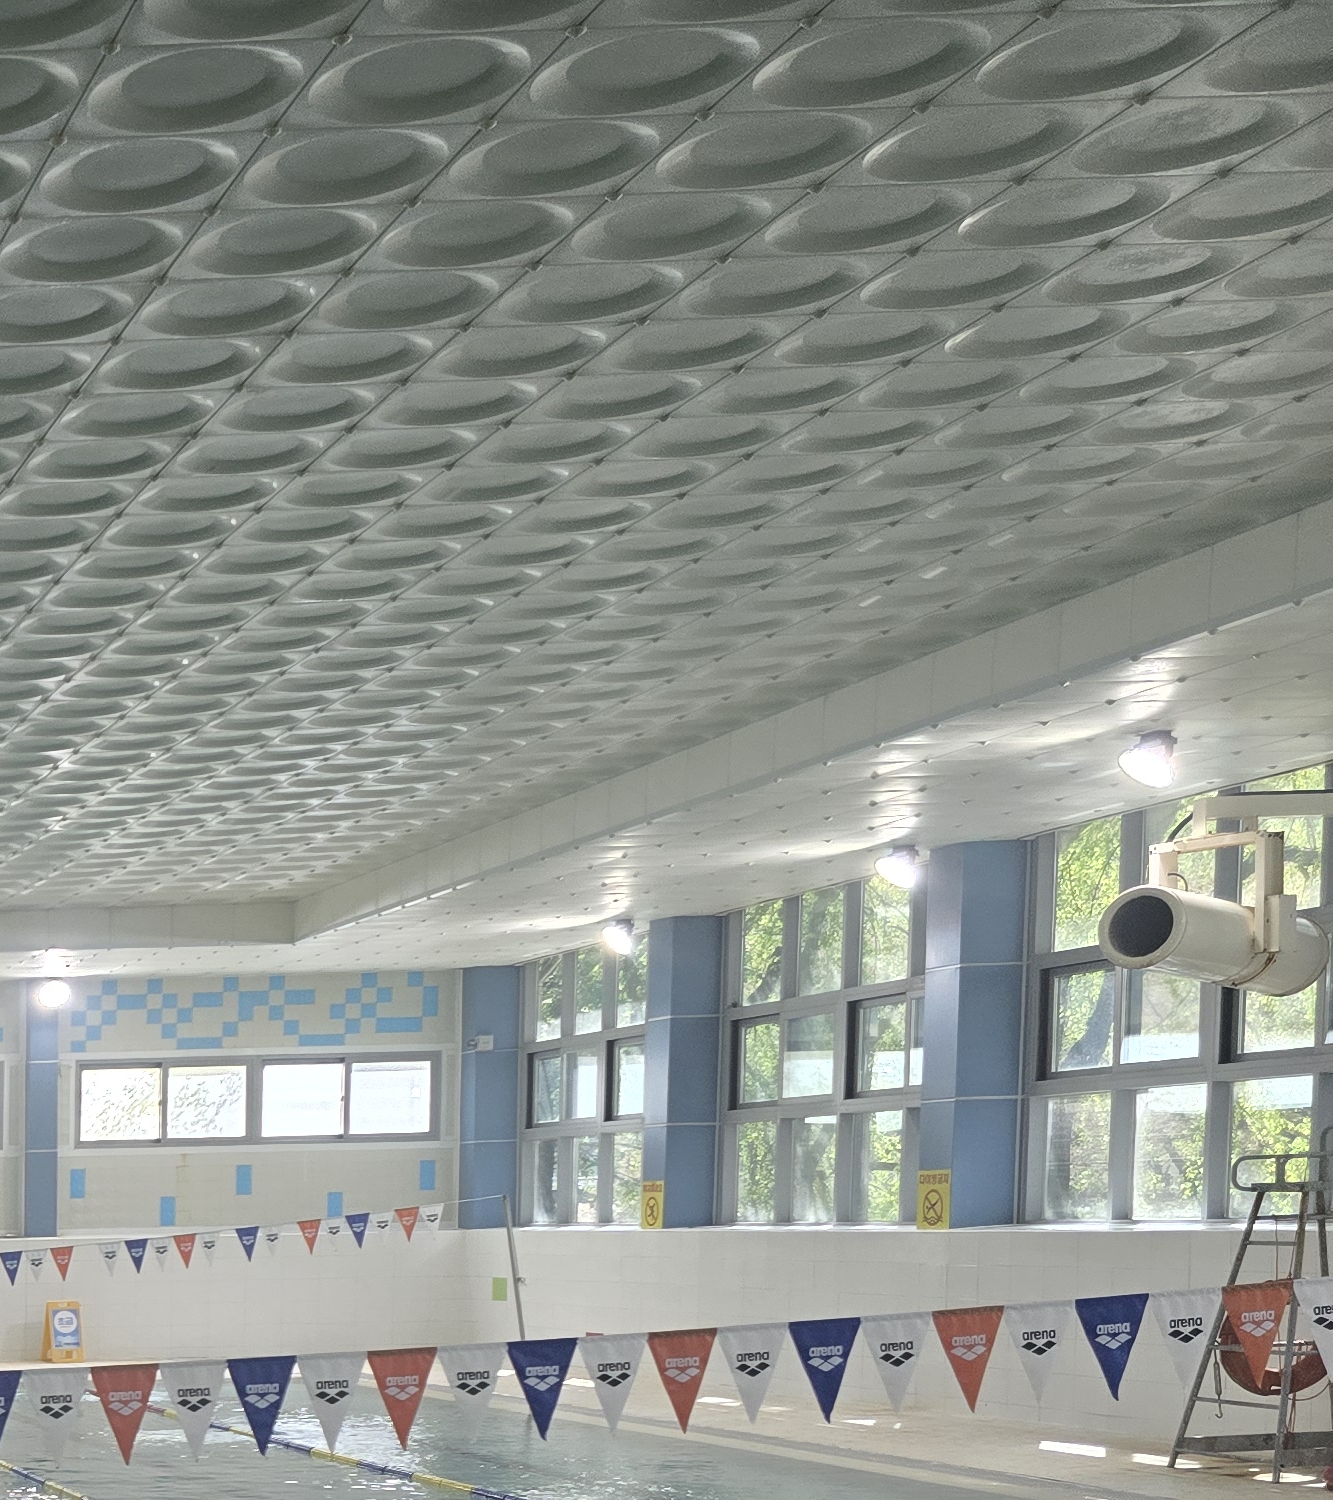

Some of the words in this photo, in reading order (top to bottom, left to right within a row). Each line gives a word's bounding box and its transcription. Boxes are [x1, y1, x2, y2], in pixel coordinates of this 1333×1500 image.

[1313, 1305, 1333, 1315] are
[1169, 1316, 1203, 1328] arena
[1241, 1310, 1274, 1323] arena
[1096, 1322, 1130, 1334] arena
[951, 1334, 986, 1346] arena
[1022, 1329, 1056, 1340] arena
[808, 1345, 843, 1358] arena
[880, 1341, 913, 1352] arena
[736, 1351, 769, 1362] arena
[598, 1361, 630, 1372] arena
[665, 1357, 700, 1369] arena
[457, 1371, 489, 1381] arena
[526, 1365, 559, 1377] arena
[316, 1379, 349, 1391] arena
[386, 1375, 419, 1386] arena
[177, 1388, 210, 1398] arena
[245, 1384, 279, 1395] arena
[40, 1394, 72, 1405] arena
[109, 1390, 142, 1402] arena
